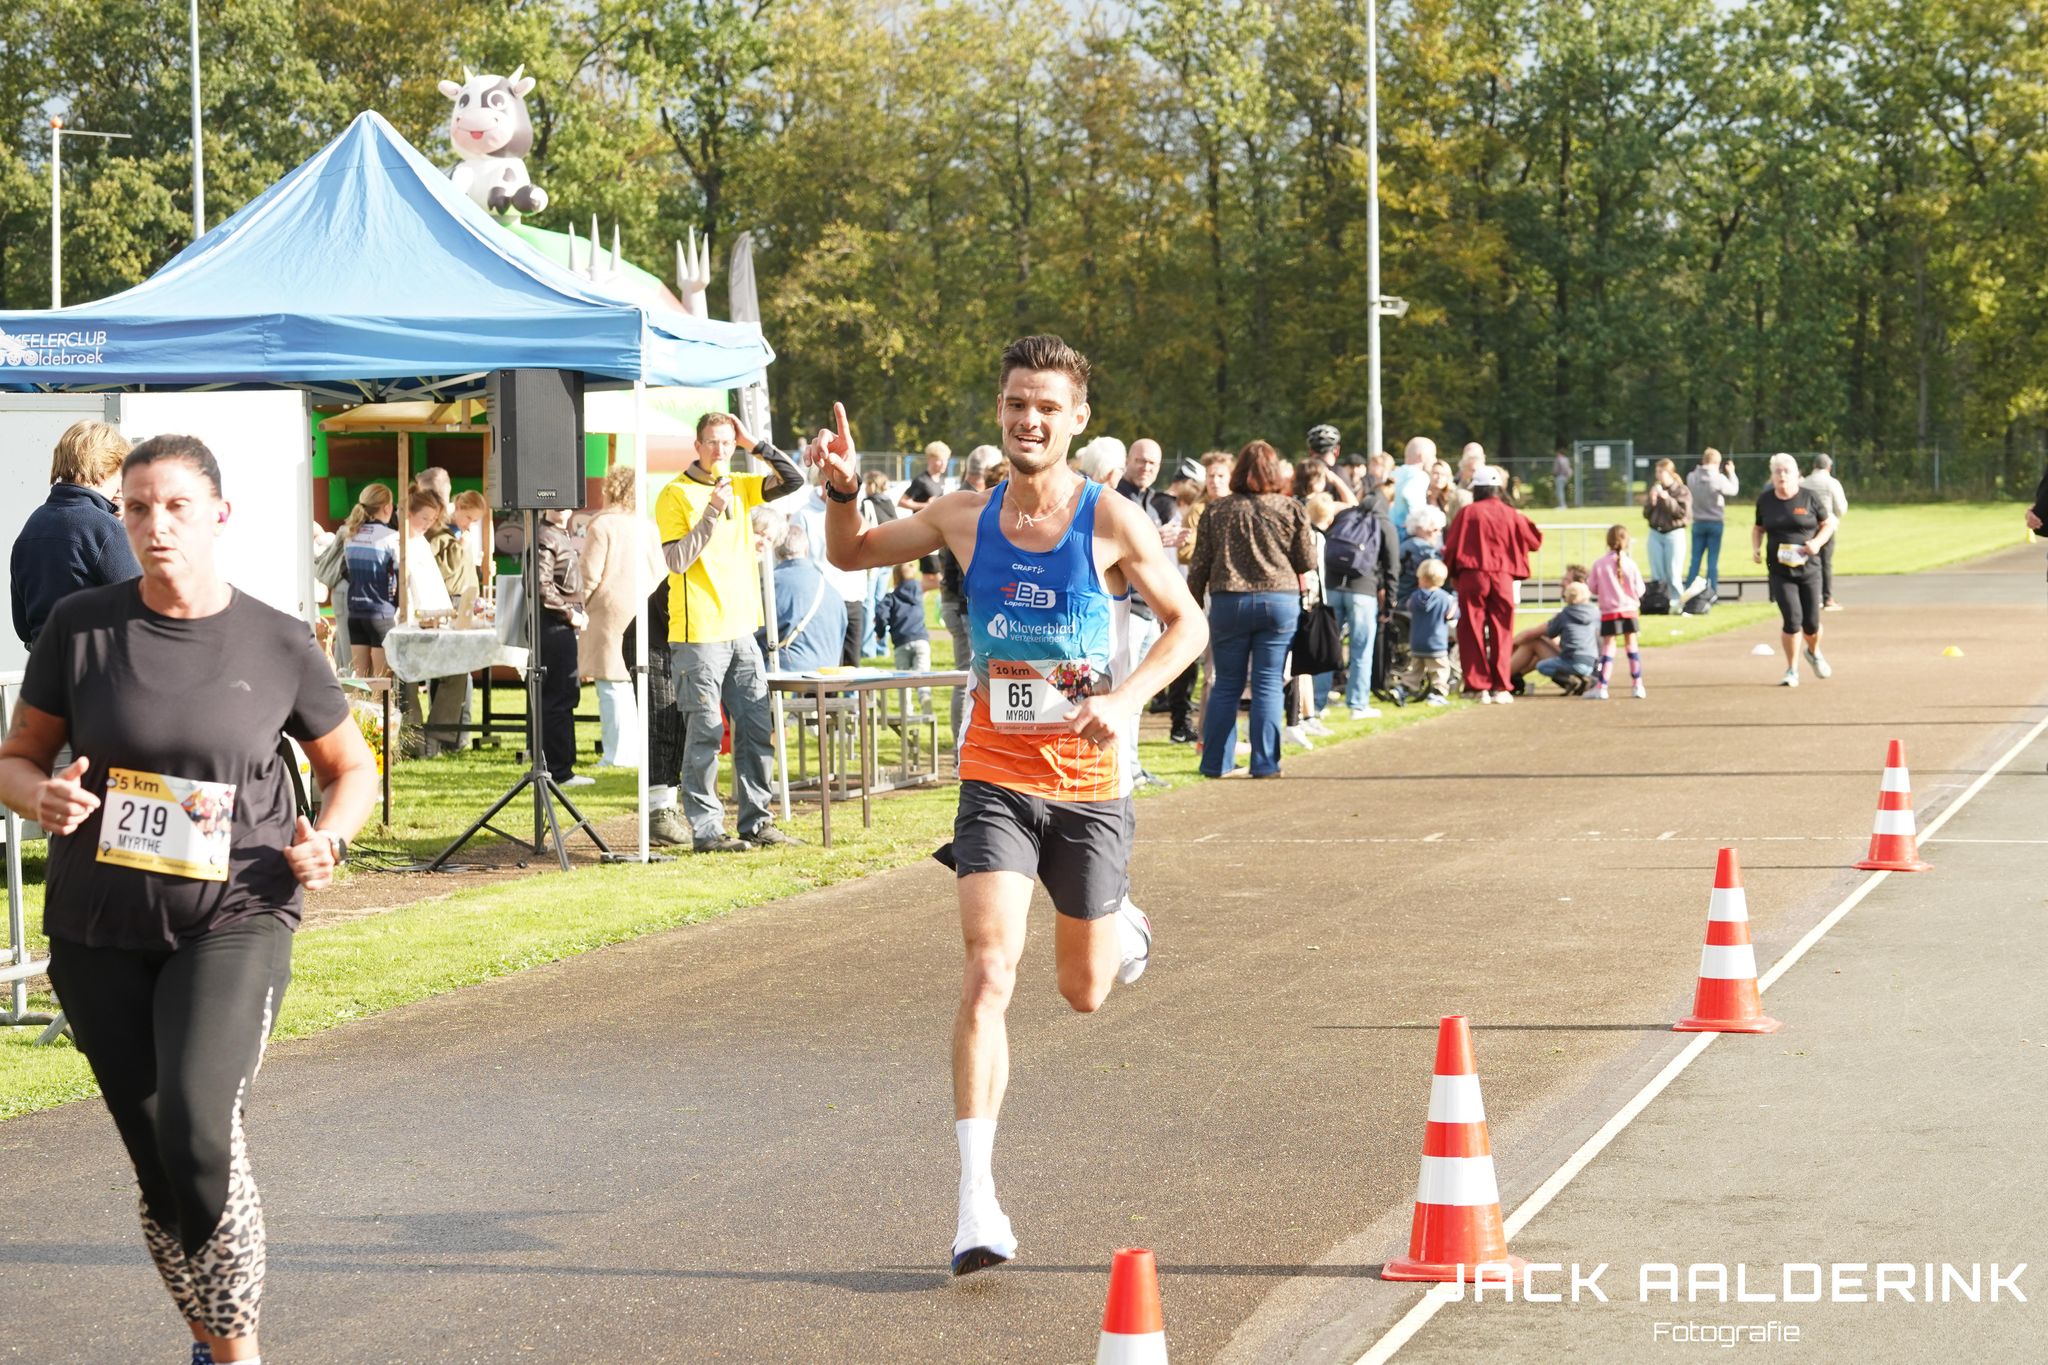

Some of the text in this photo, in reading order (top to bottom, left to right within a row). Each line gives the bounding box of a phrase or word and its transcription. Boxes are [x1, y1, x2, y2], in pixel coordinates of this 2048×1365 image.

[1011, 563, 1037, 573] CRAFT
[1004, 599, 1030, 608] Lopers
[1009, 620, 1075, 635] Klaverblad
[1011, 666, 1030, 676] km
[1008, 683, 1032, 708] 65
[1005, 710, 1035, 721] MYRON
[119, 776, 159, 793] 5 km
[118, 800, 168, 837] 219
[117, 834, 162, 853] MYRTHE
